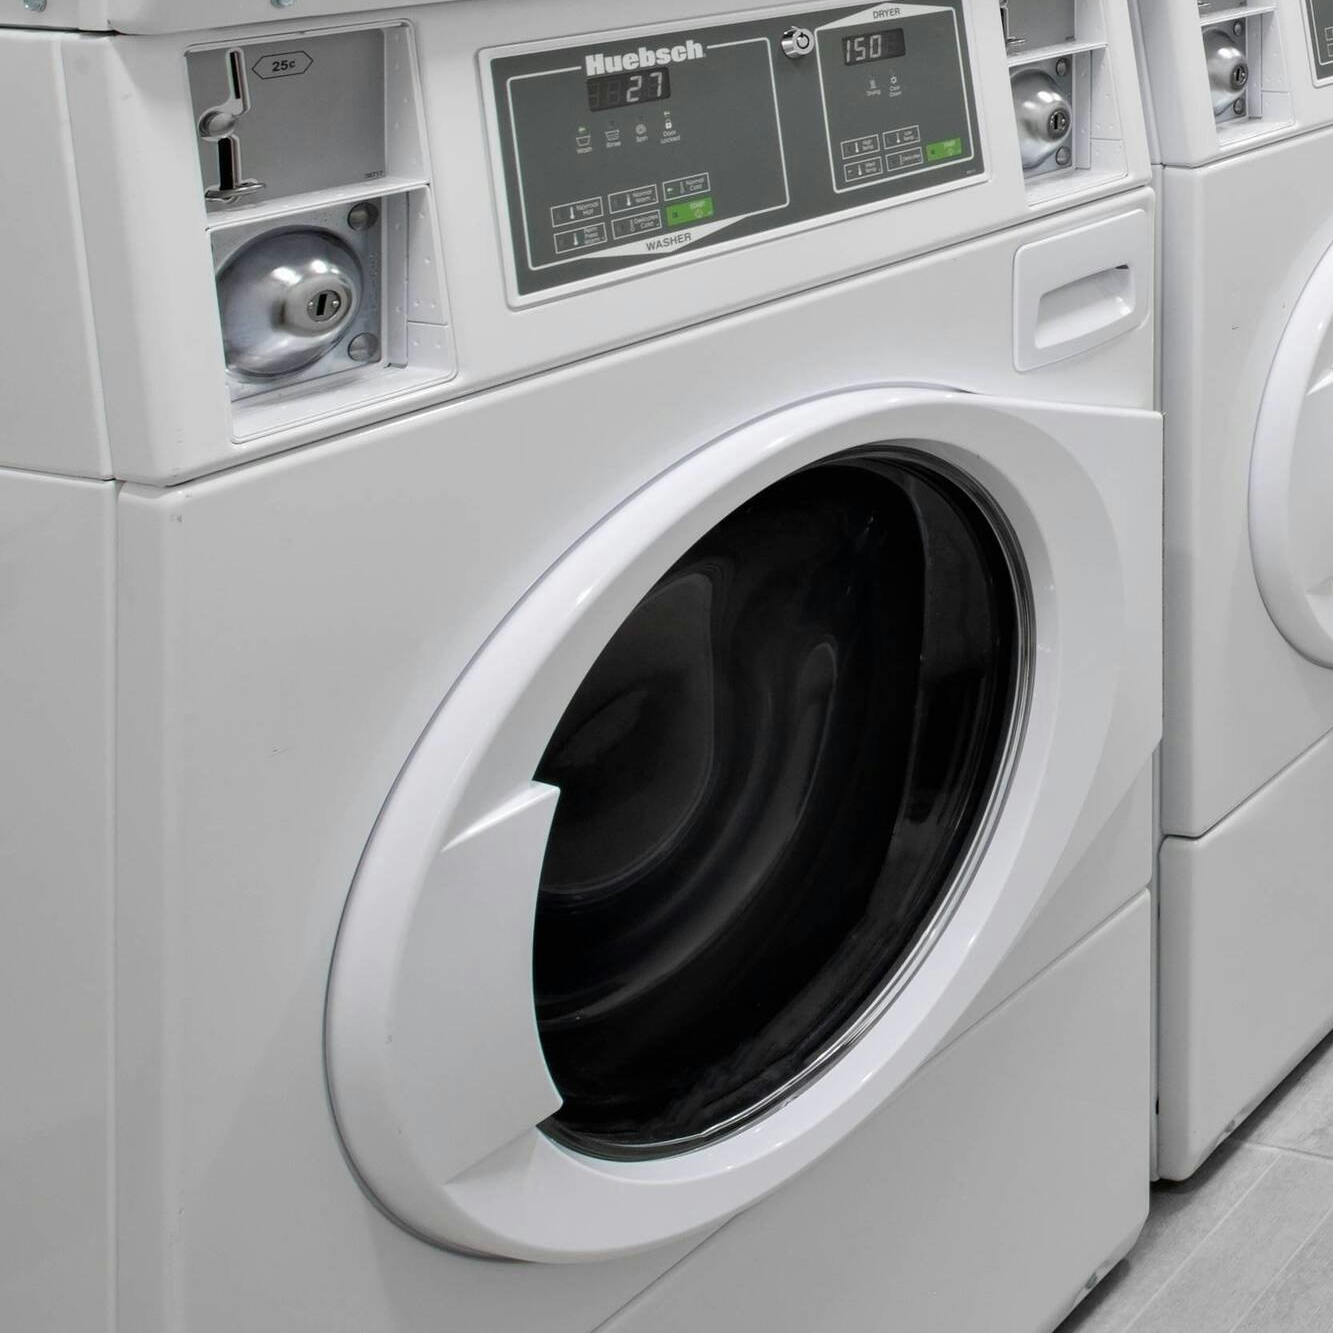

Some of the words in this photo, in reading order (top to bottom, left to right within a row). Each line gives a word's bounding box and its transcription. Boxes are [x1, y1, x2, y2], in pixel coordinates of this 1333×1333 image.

[872, 8, 900, 18] DRYER
[585, 40, 704, 76] Huebsch
[846, 34, 882, 63] 150
[626, 71, 662, 102] 27
[646, 232, 692, 251] WASHER
